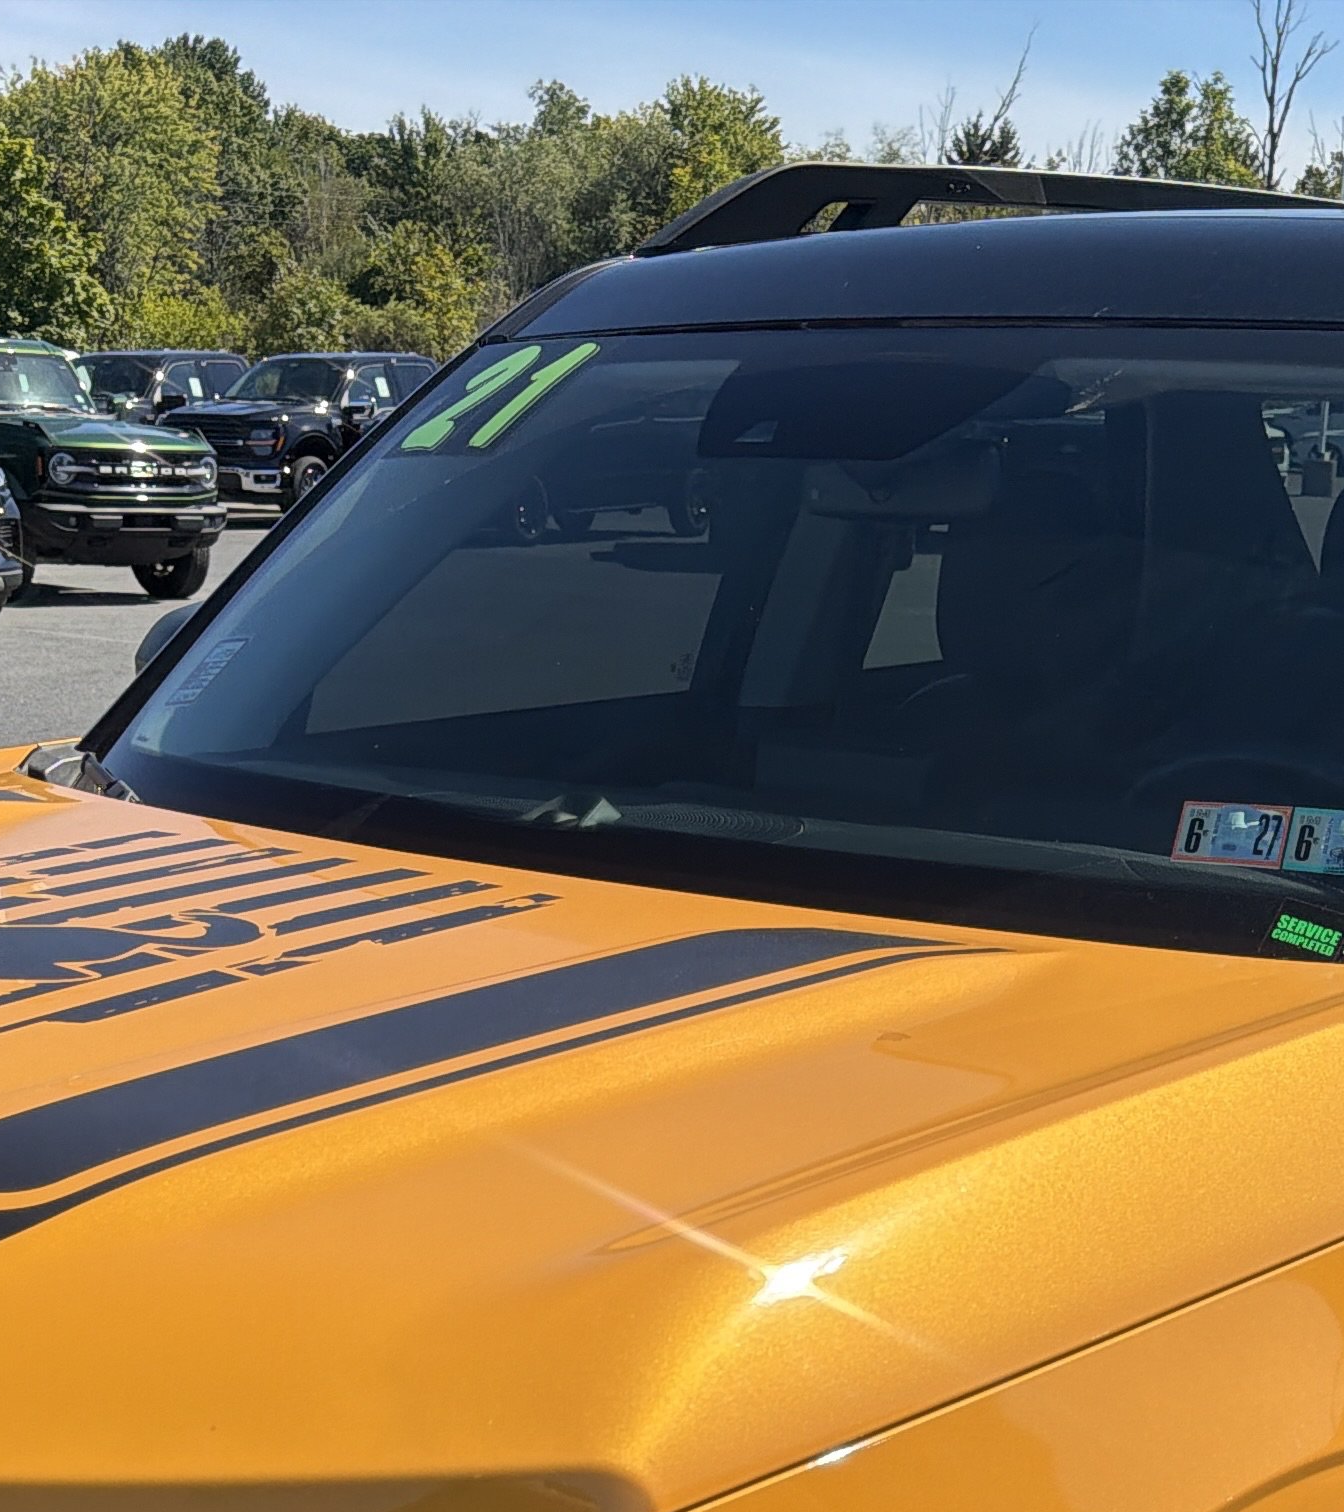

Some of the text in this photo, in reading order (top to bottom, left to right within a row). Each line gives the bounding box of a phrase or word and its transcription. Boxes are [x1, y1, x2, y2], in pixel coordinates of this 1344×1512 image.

[401, 343, 600, 451] 21
[1184, 814, 1285, 859] 6 27
[1294, 824, 1314, 861] 6
[1271, 928, 1336, 957] COMPLETED
[1277, 914, 1343, 947] SERVICE
